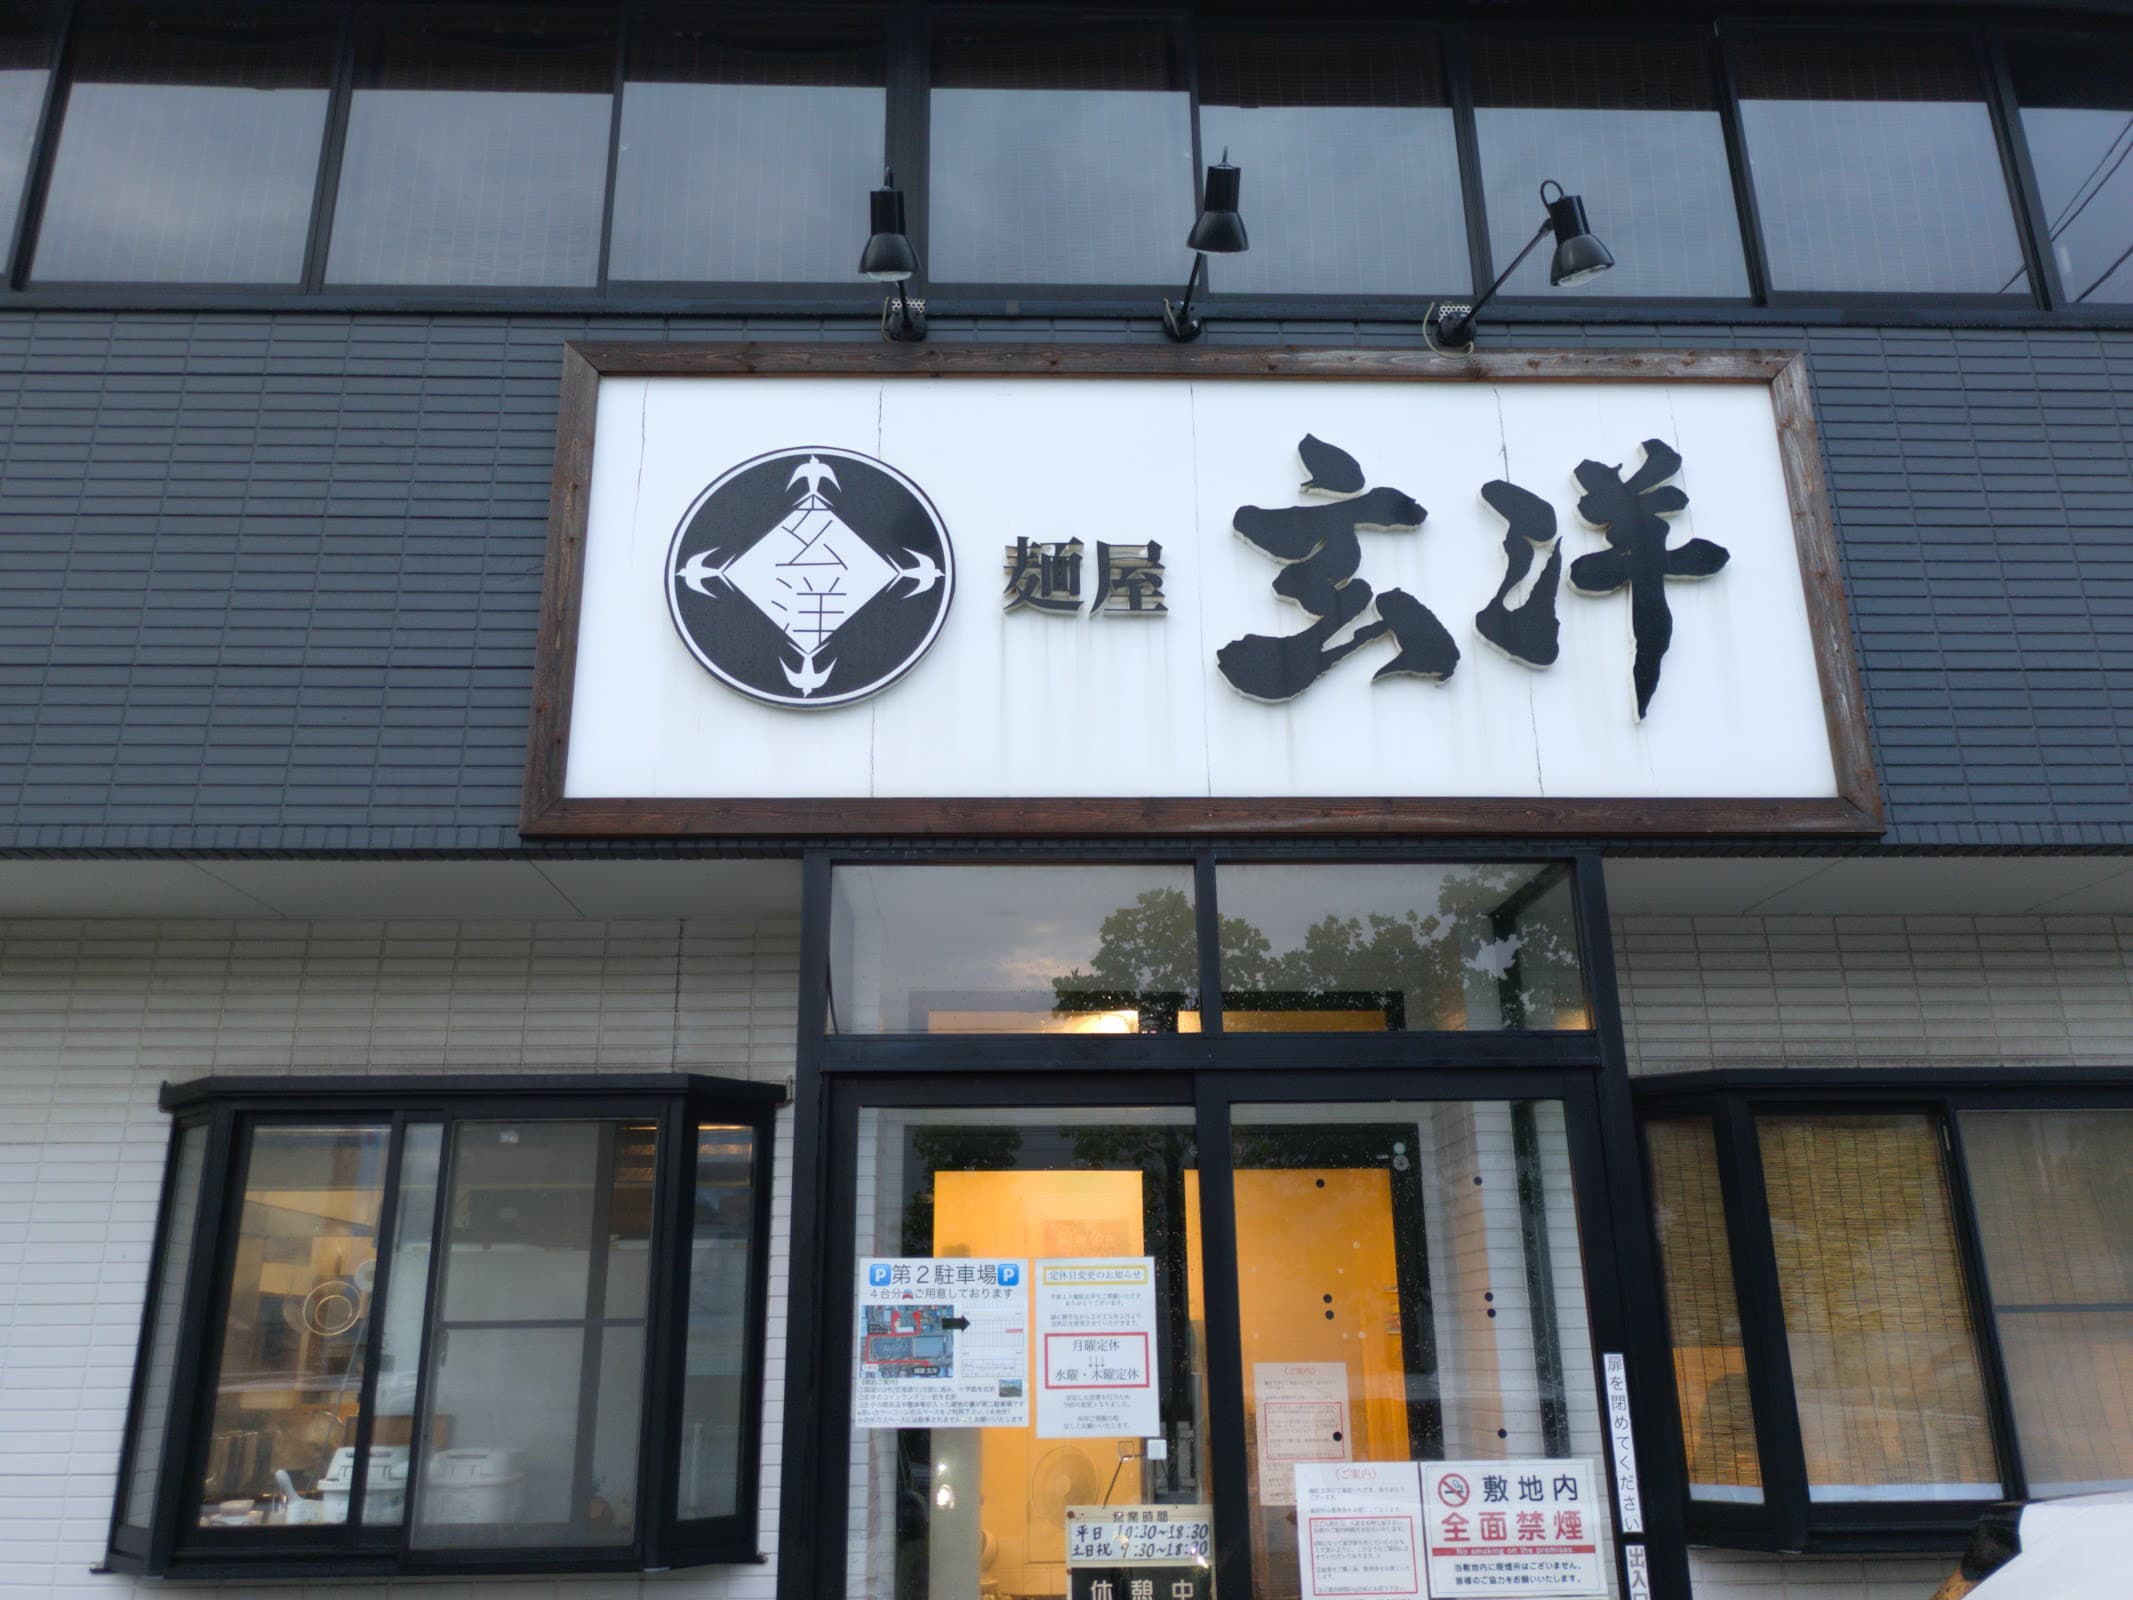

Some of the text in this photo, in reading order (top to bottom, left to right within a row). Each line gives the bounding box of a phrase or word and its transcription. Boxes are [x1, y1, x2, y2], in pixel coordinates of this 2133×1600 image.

[1217, 433, 1730, 723] 玄洋
[1073, 1339, 1120, 1352] 月曜定休
[1606, 1356, 1641, 1532] 扉を閉めてください
[1482, 1474, 1578, 1503] 敷地内
[1077, 1525, 1102, 1542] 平日
[1441, 1510, 1584, 1542] 全面禁煙
[1072, 1543, 1112, 1557] 土日祝
